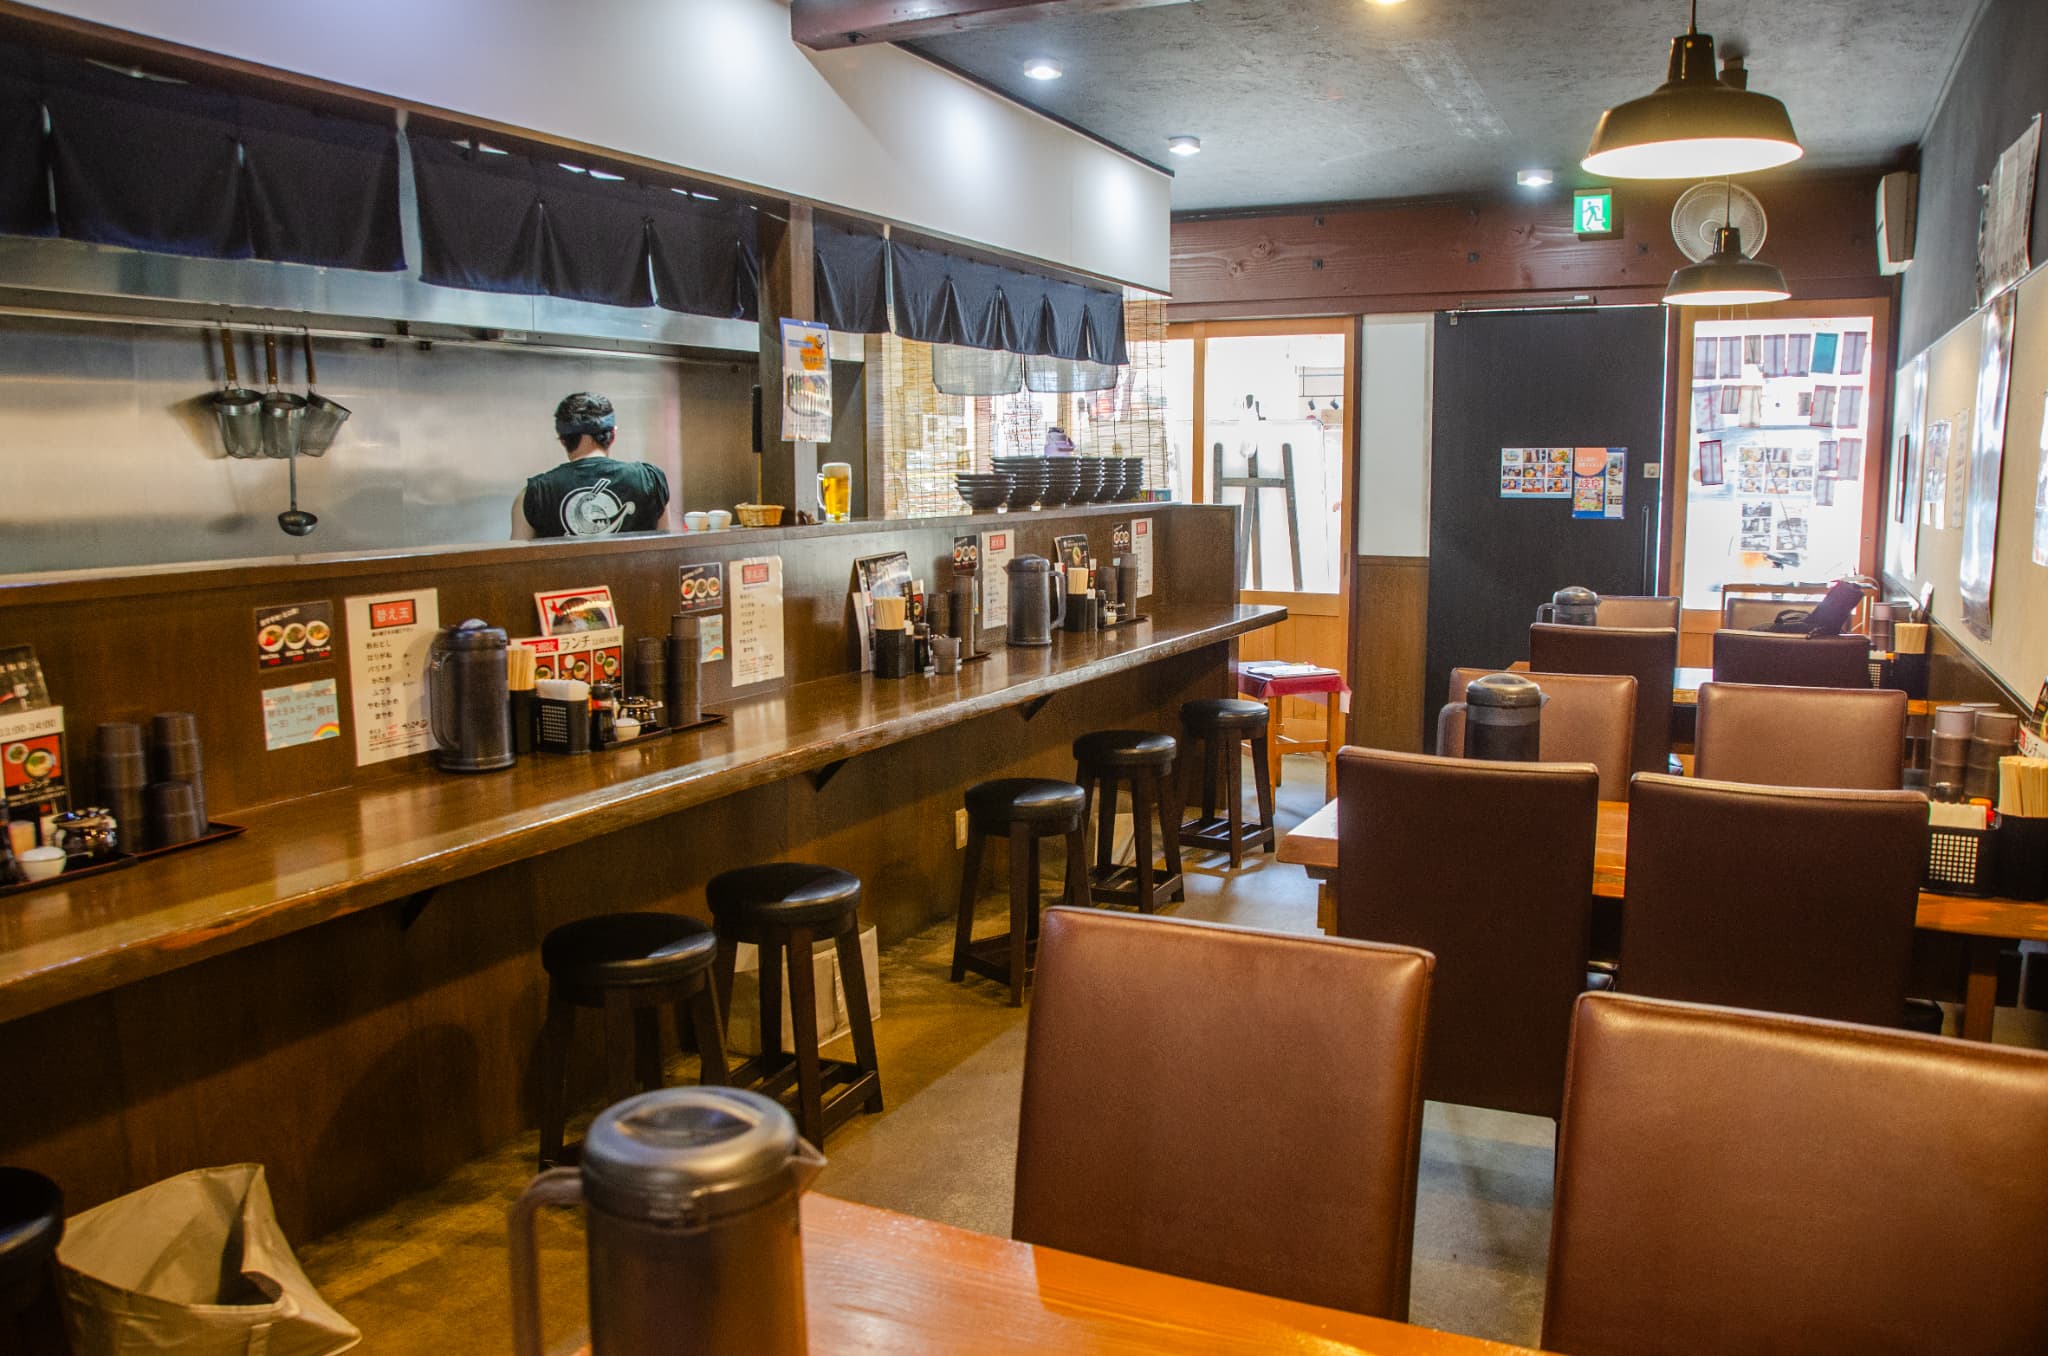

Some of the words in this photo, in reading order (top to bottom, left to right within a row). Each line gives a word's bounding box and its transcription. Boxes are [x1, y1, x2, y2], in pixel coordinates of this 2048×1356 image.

[376, 606, 410, 623] 替え玉
[559, 634, 591, 651] ランチ
